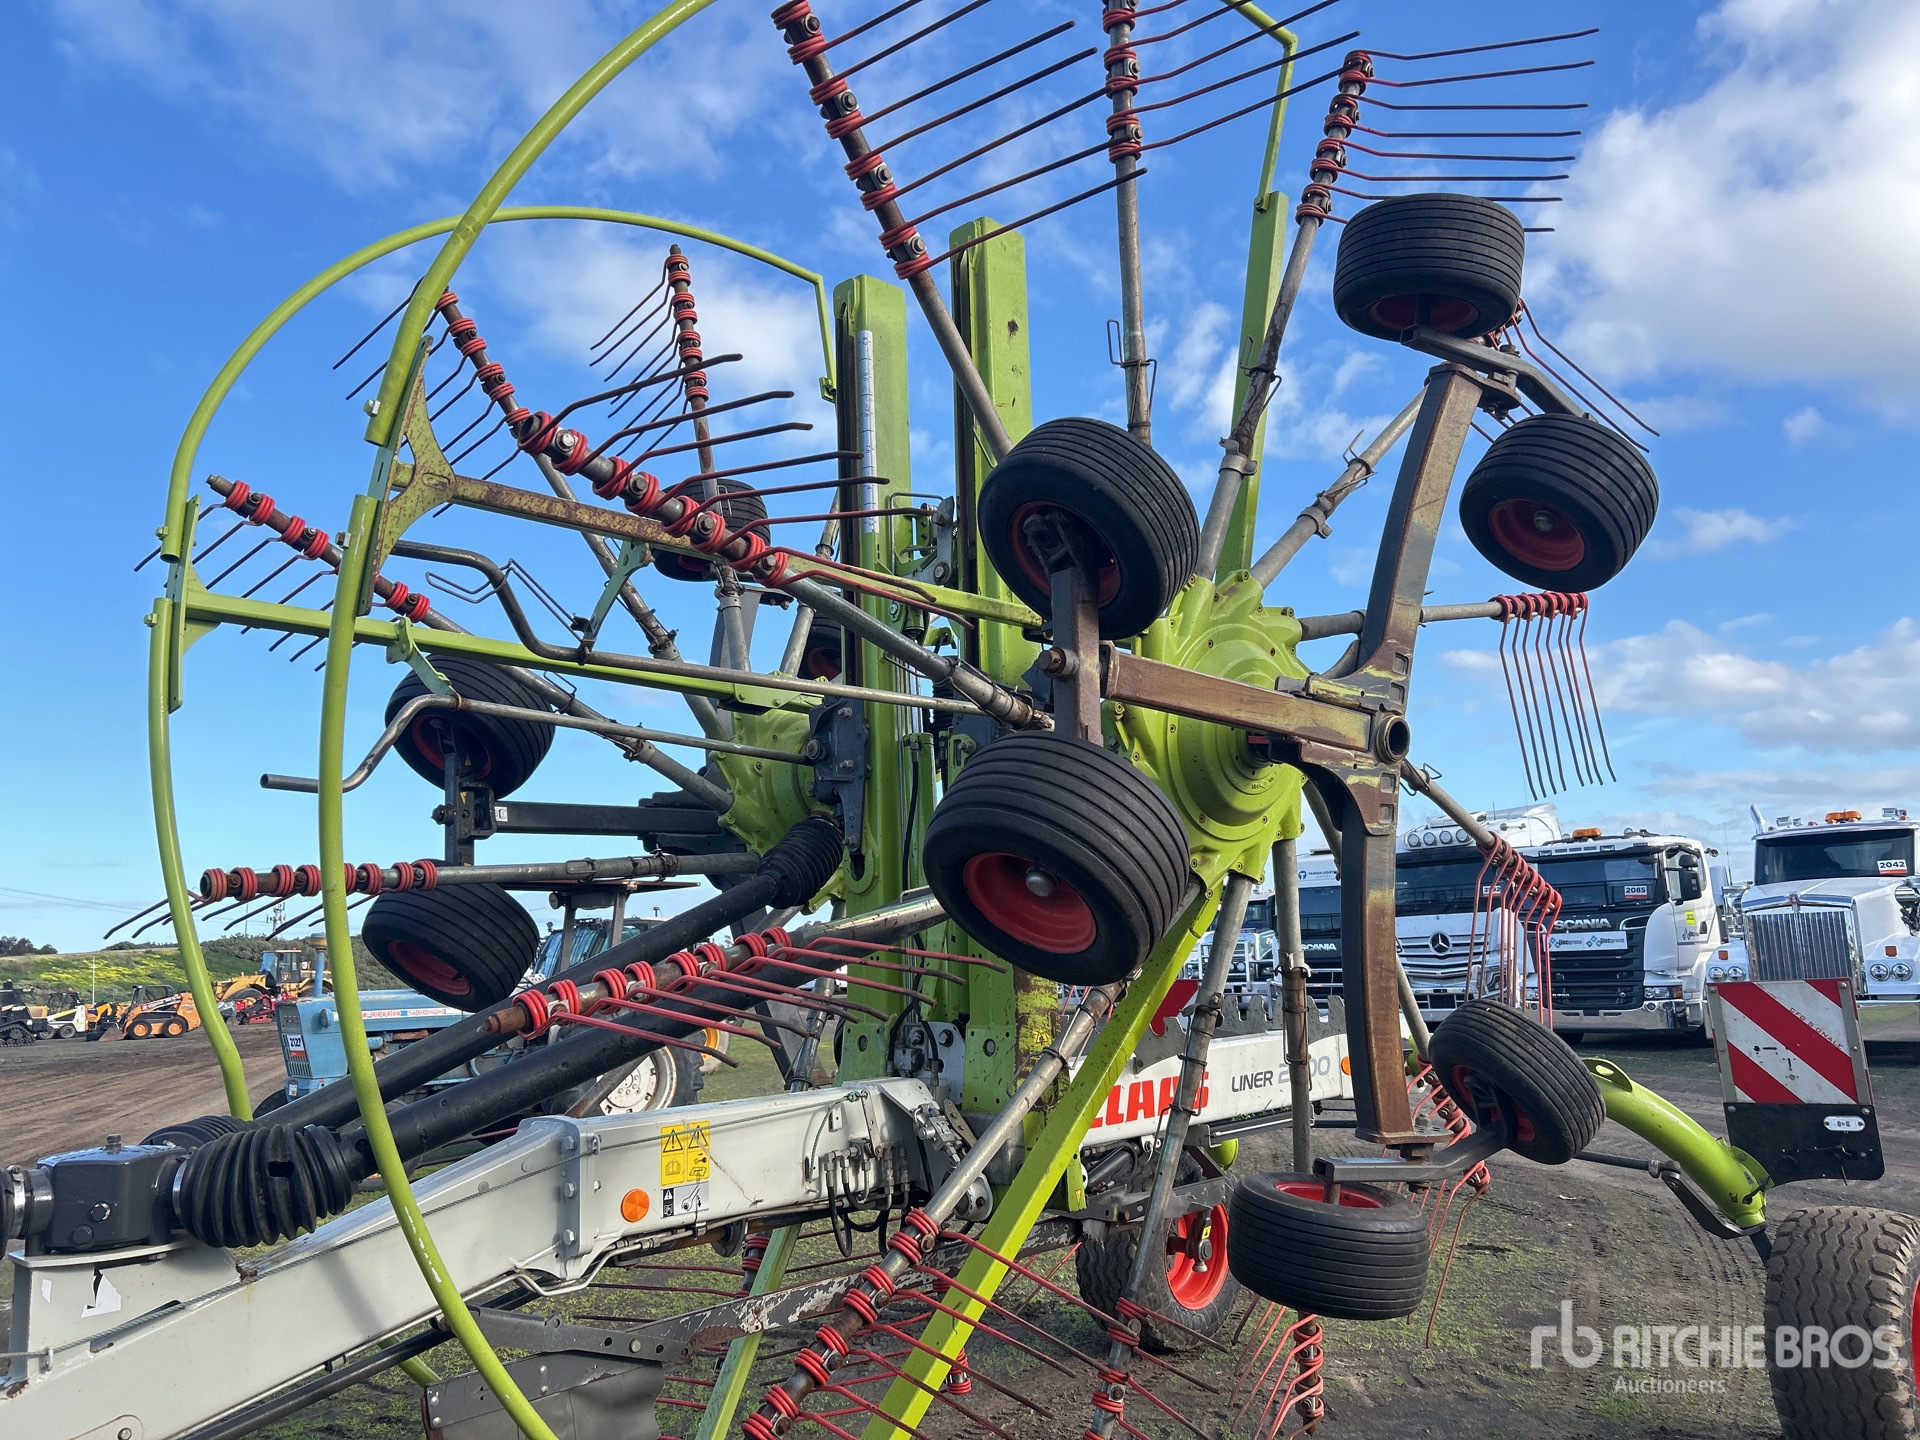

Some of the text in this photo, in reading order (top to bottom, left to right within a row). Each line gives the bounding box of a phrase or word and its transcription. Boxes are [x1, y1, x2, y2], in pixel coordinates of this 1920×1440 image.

[1879, 861, 1906, 869] 2042
[1553, 918, 1612, 931] SCANIA
[1301, 943, 1337, 951] SCANIA
[1231, 1055, 1331, 1093] LINER 200
[1090, 1071, 1209, 1129] LAAS
